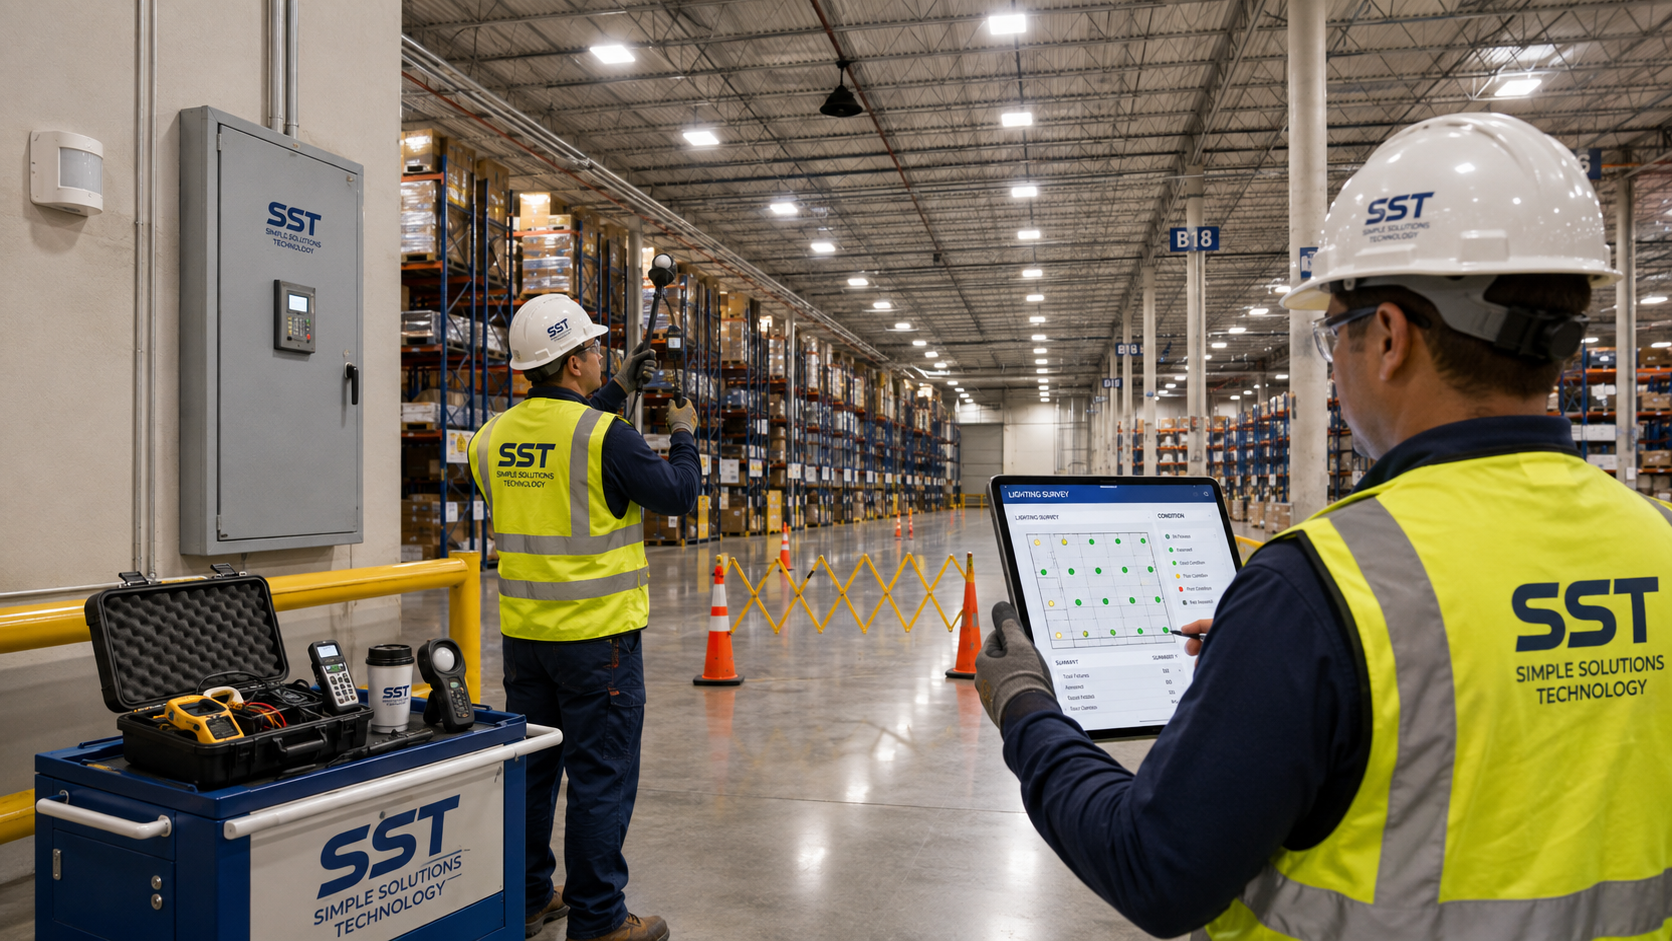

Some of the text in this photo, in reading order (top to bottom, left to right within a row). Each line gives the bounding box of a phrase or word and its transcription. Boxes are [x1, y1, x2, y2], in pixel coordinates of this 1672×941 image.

[266, 201, 322, 236] SST
[1365, 191, 1435, 226] SST
[289, 233, 322, 248] SOLUTIONS
[1176, 229, 1213, 248] B18
[1362, 222, 1431, 236] SIMPLE SOLUTIONS
[1369, 231, 1419, 243] TECHNOLOGY
[547, 318, 569, 338] SST
[498, 442, 556, 468] SST
[496, 470, 555, 480] SIMPLE SOLUTIONS
[503, 480, 546, 488] TECHNOLOGY
[1008, 490, 1069, 498] LIGHTING SURVEY
[1511, 576, 1659, 652] SST
[1516, 655, 1665, 683] SIMPLE SOLUTIONS
[383, 685, 410, 699] SST
[1536, 679, 1648, 705] TECHNOLOGY
[316, 794, 461, 900] SST
[314, 855, 462, 926] SIMPLE SOLUTIONS
[334, 879, 446, 938] TECHNOLOGY
